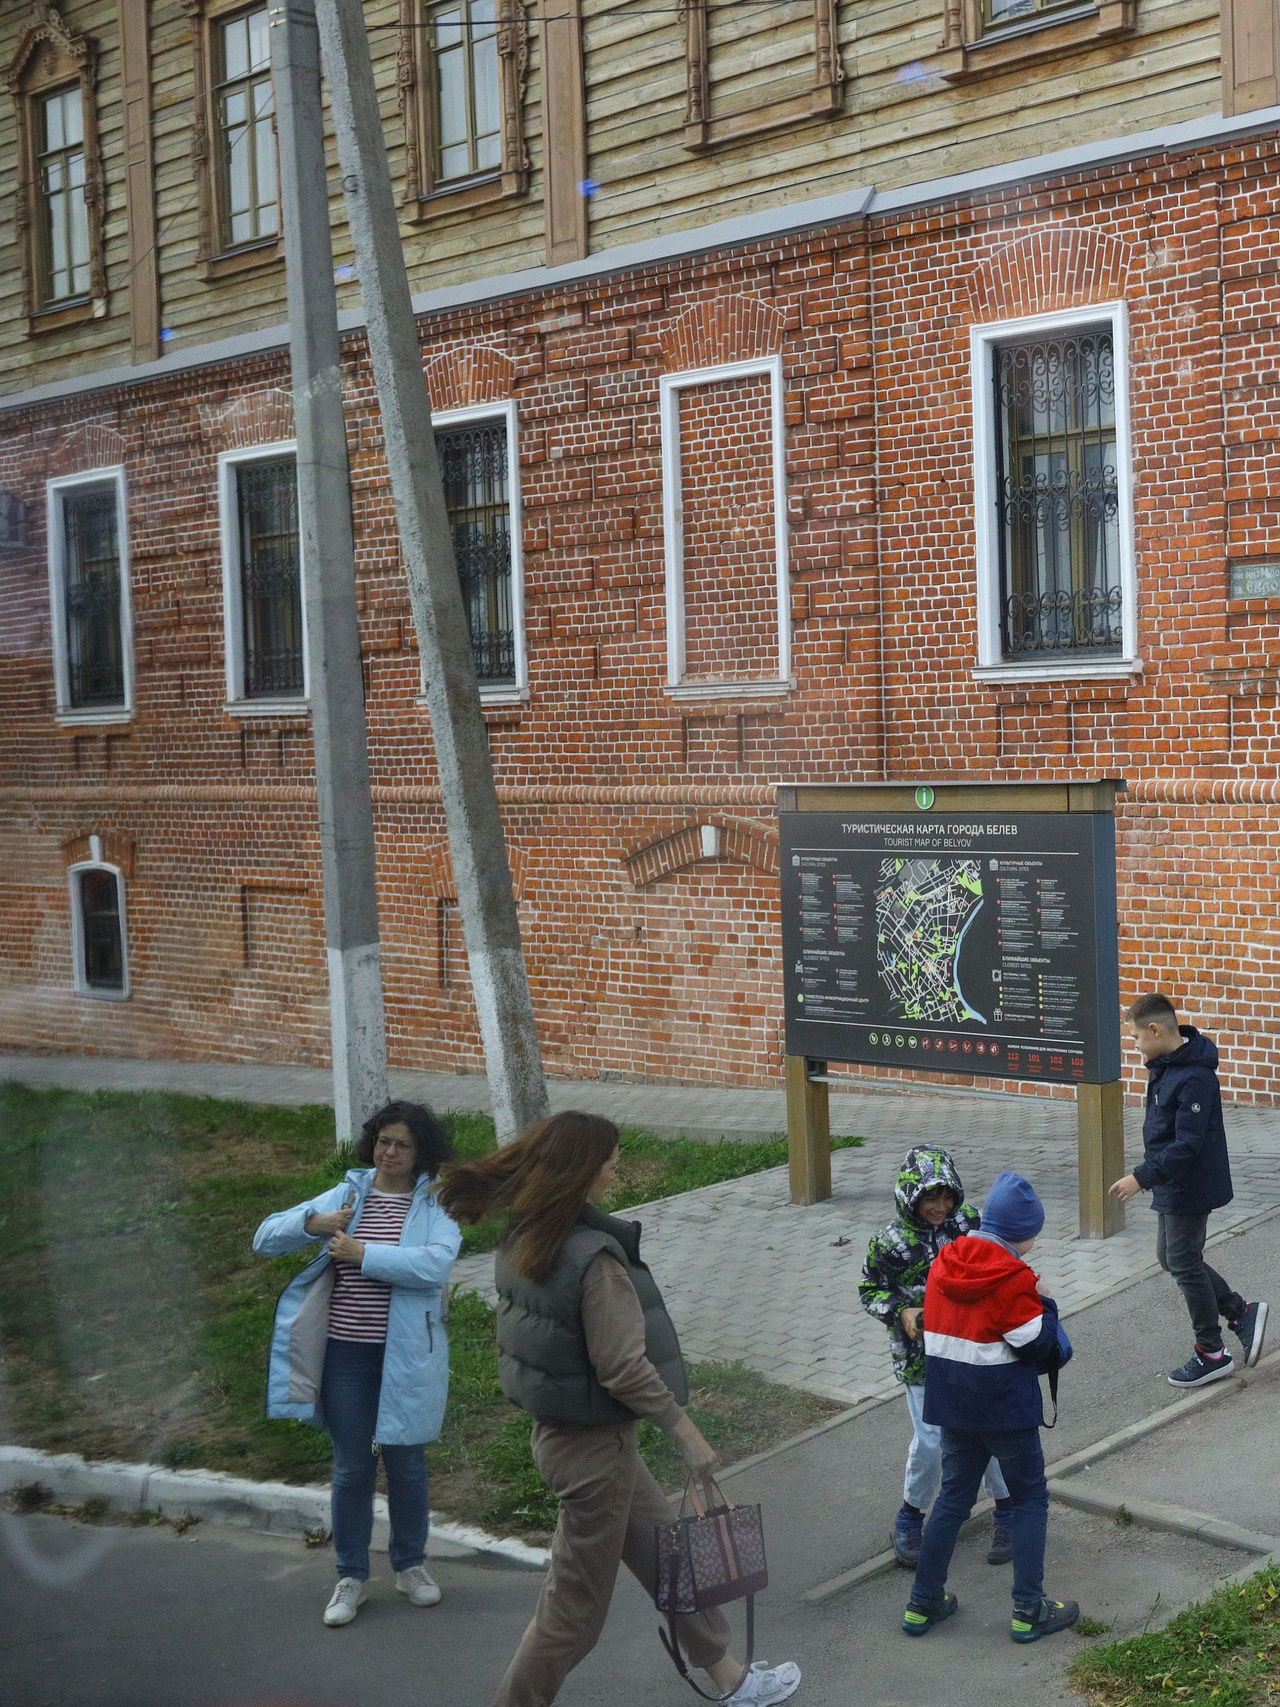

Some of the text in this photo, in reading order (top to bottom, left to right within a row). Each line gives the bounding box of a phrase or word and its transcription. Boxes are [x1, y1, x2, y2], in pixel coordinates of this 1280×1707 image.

[841, 823, 1018, 837] ТУРИСТИЧЕСКАЯ КАРТА ГОРОДА БЕЛЕВ
[884, 837, 972, 848] TOURIST MAP OF BELYOV
[1028, 1054, 1041, 1062] 101
[1049, 1056, 1063, 1064] 102
[1071, 1058, 1084, 1066] 103
